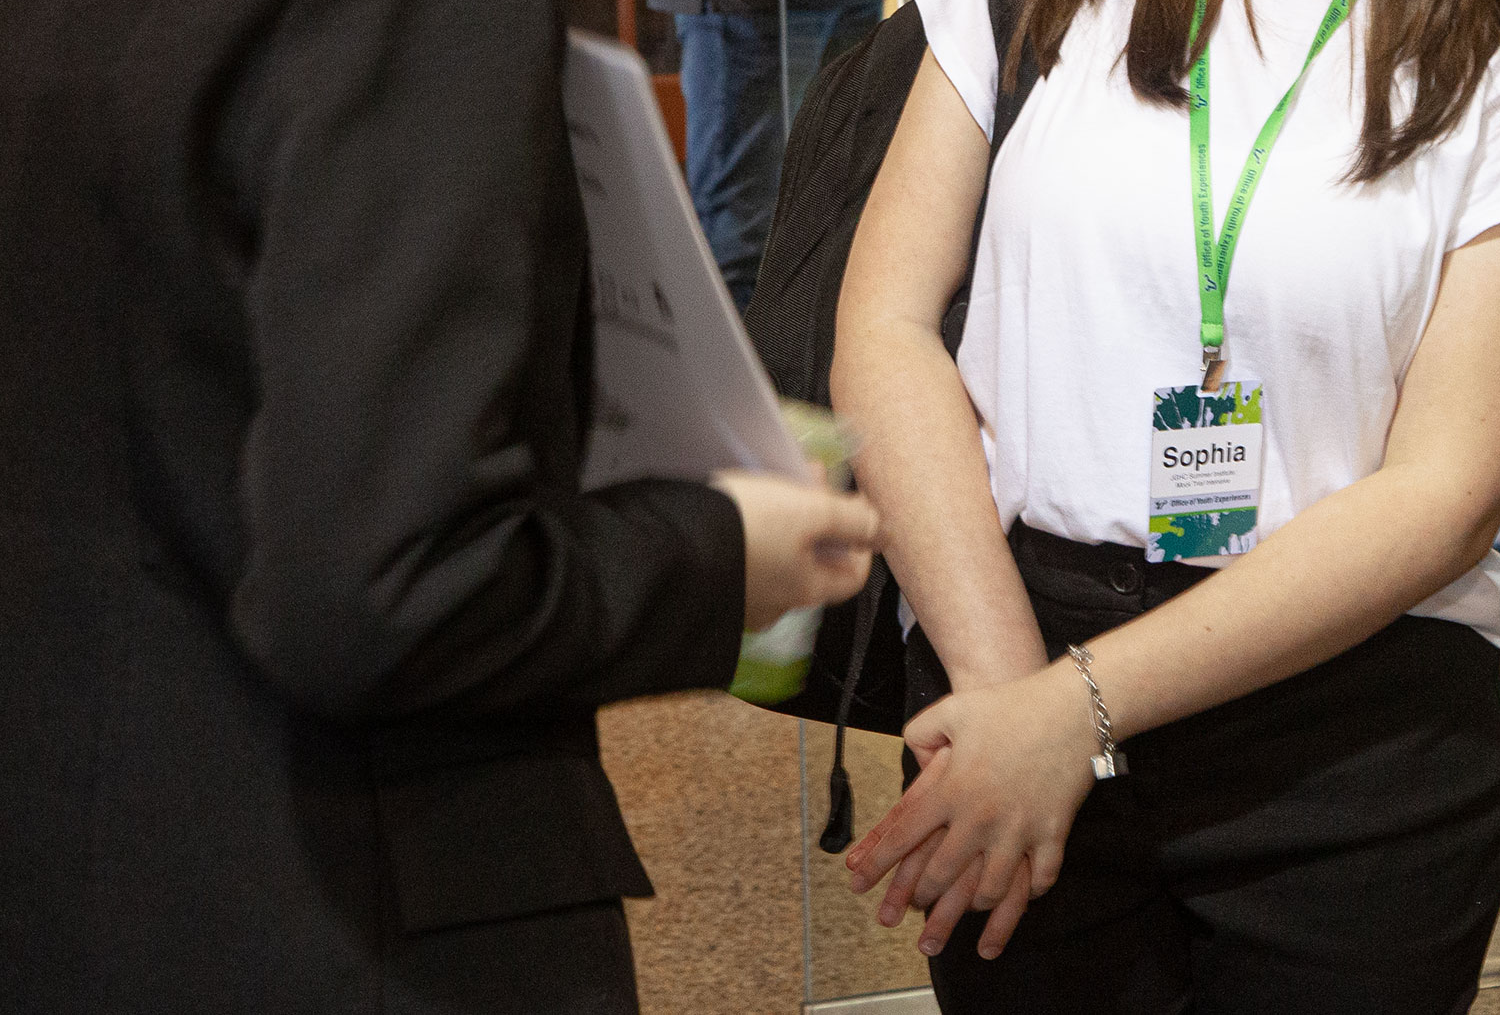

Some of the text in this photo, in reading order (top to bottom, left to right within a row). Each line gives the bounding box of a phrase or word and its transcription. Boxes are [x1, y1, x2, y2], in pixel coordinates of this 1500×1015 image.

[1240, 169, 1257, 194] Office
[1197, 143, 1213, 268] Office of Youth Experiences
[1236, 194, 1245, 206] of
[1226, 207, 1242, 232] Youth
[1162, 441, 1247, 472] Sophia
[1170, 499, 1189, 508] Office
[1197, 497, 1214, 506] Youth
[1215, 494, 1251, 504] Experiences
